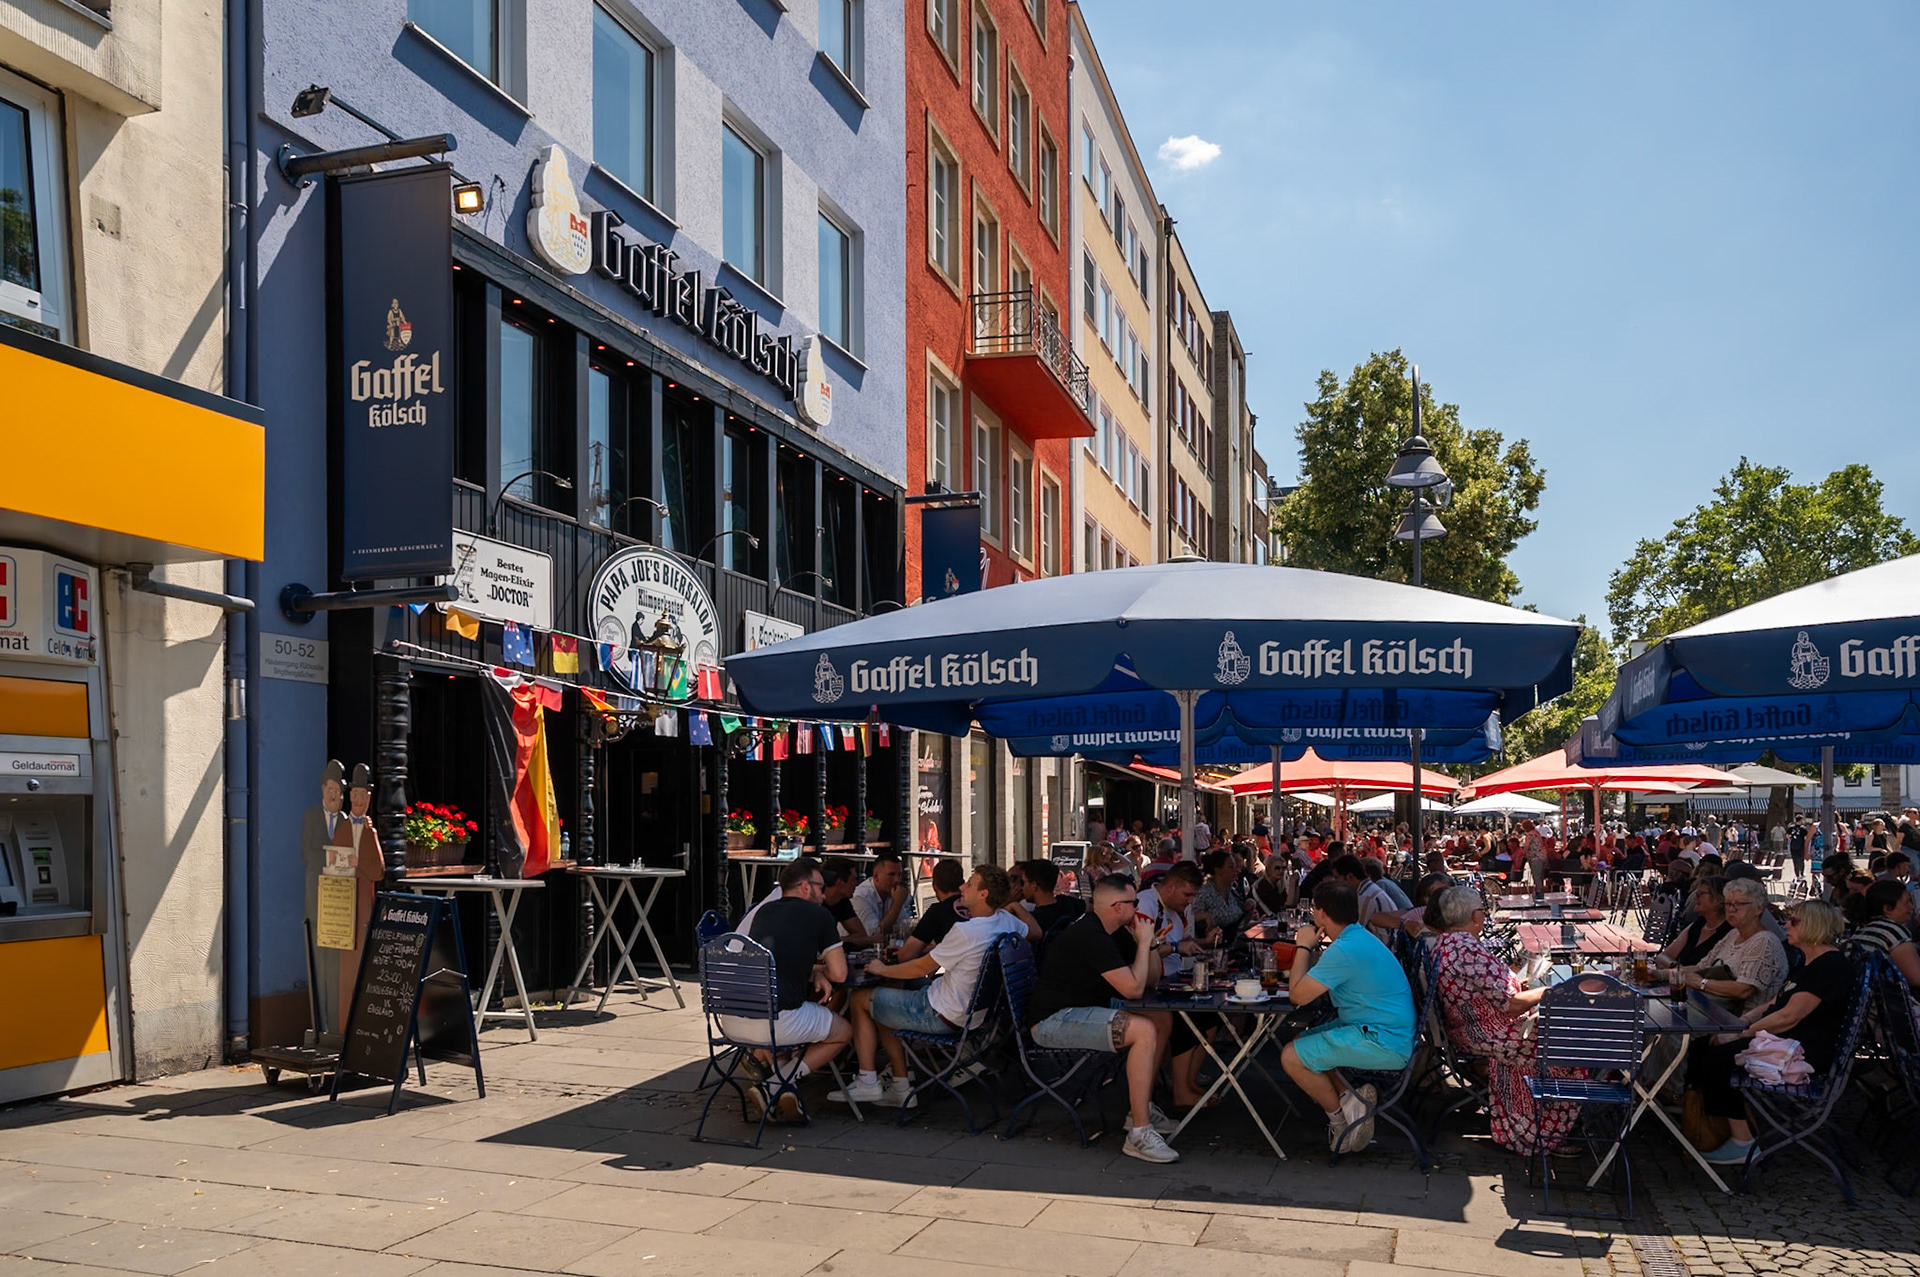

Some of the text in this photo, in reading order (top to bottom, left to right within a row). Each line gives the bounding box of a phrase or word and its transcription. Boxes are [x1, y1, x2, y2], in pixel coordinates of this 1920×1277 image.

[592, 210, 800, 401] Gaffel Kölsch
[351, 350, 445, 402] Gaffel
[369, 399, 427, 428] Kölsch
[480, 567, 534, 588] Magen-Elixir
[497, 558, 524, 573] Bestes
[600, 567, 629, 612] PAPA
[663, 563, 713, 636] BIERSALON
[274, 639, 315, 658] 50-52
[1259, 637, 1473, 680] Gaffel Kölsch
[850, 647, 1038, 694] Gaffel Kölsch
[12, 760, 75, 771] Geldautomat
[387, 908, 429, 926] Gaffel Kölsch
[367, 1003, 394, 1017] ENGLAND
